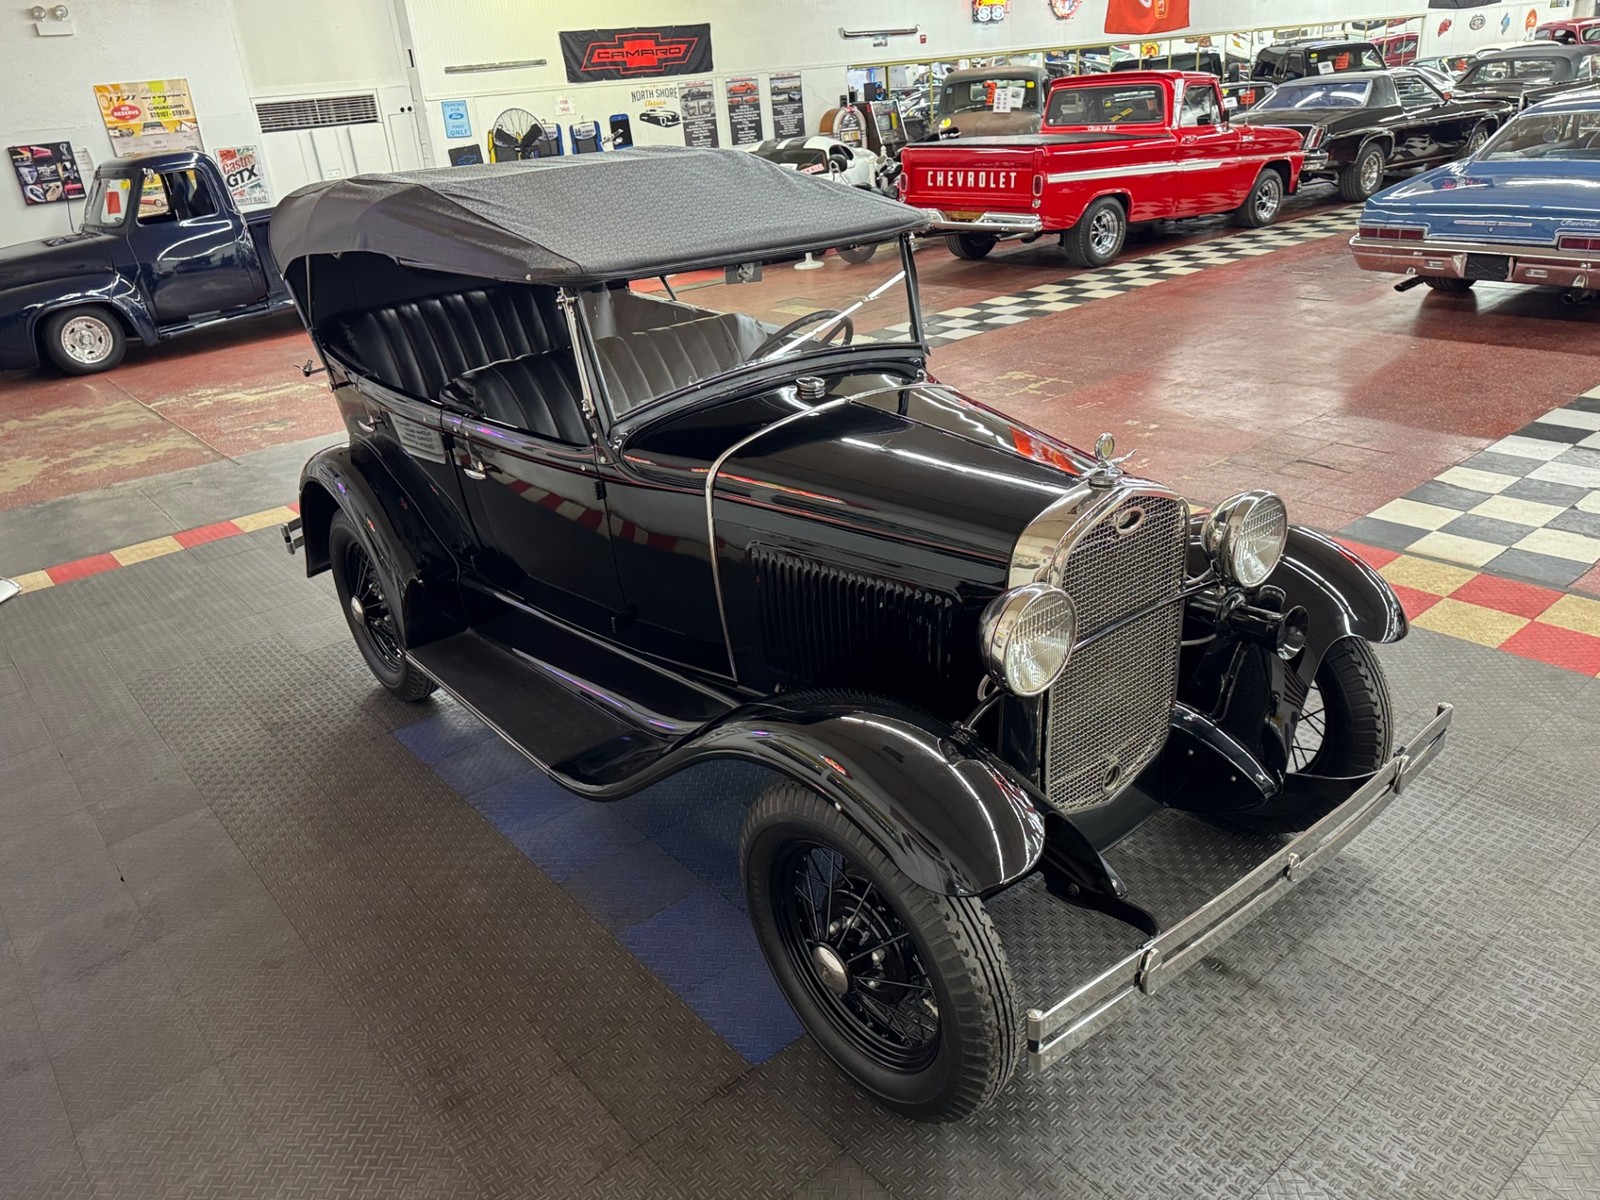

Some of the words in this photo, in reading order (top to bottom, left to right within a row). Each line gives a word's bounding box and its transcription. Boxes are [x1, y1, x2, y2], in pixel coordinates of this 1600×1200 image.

[597, 46, 682, 59] CAMARO
[631, 90, 655, 103] NORTH
[655, 87, 678, 99] SHORE
[113, 109, 140, 117] RESERVE
[222, 152, 256, 175] Castro
[226, 164, 258, 187] GTX
[927, 170, 1017, 189] CHEVROLET
